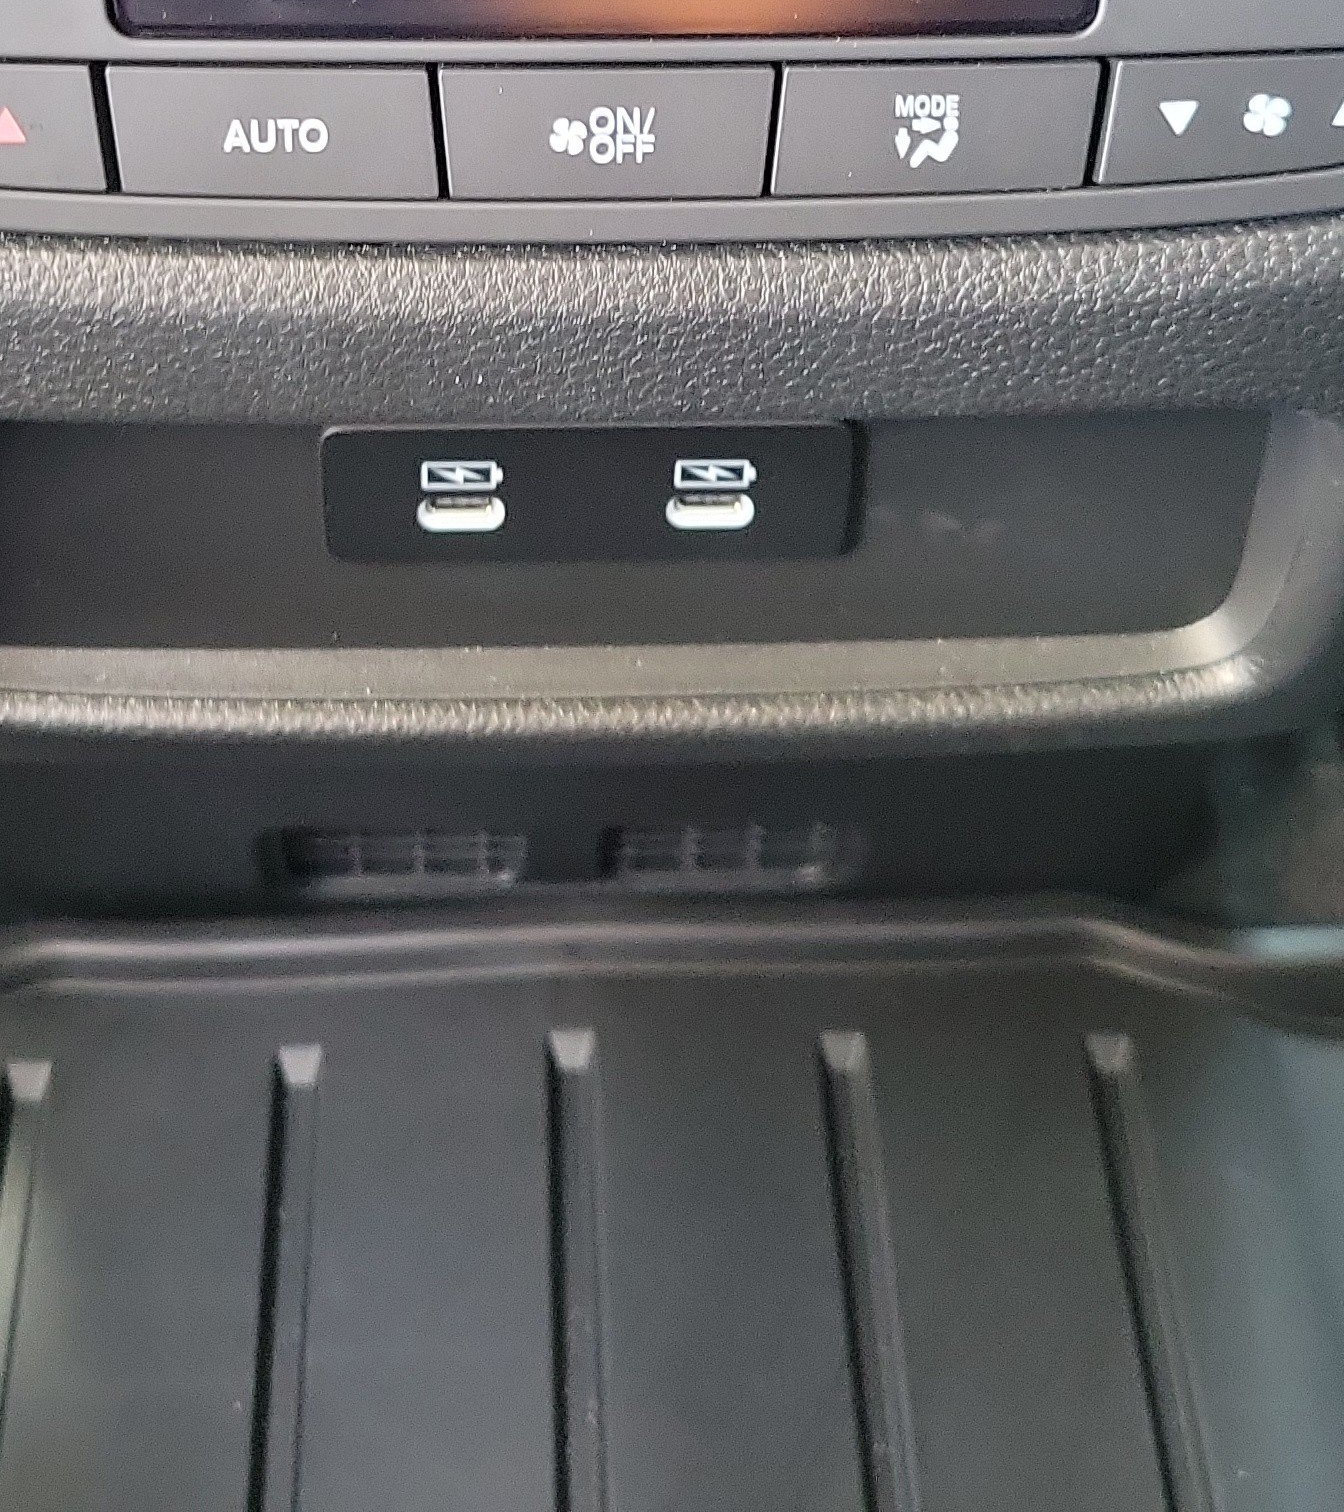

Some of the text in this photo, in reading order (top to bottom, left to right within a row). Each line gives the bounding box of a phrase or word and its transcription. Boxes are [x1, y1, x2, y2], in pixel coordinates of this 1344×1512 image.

[588, 106, 656, 136] ON/
[895, 93, 960, 119] MODE
[222, 117, 330, 154] AUTO
[588, 134, 656, 165] OFF
